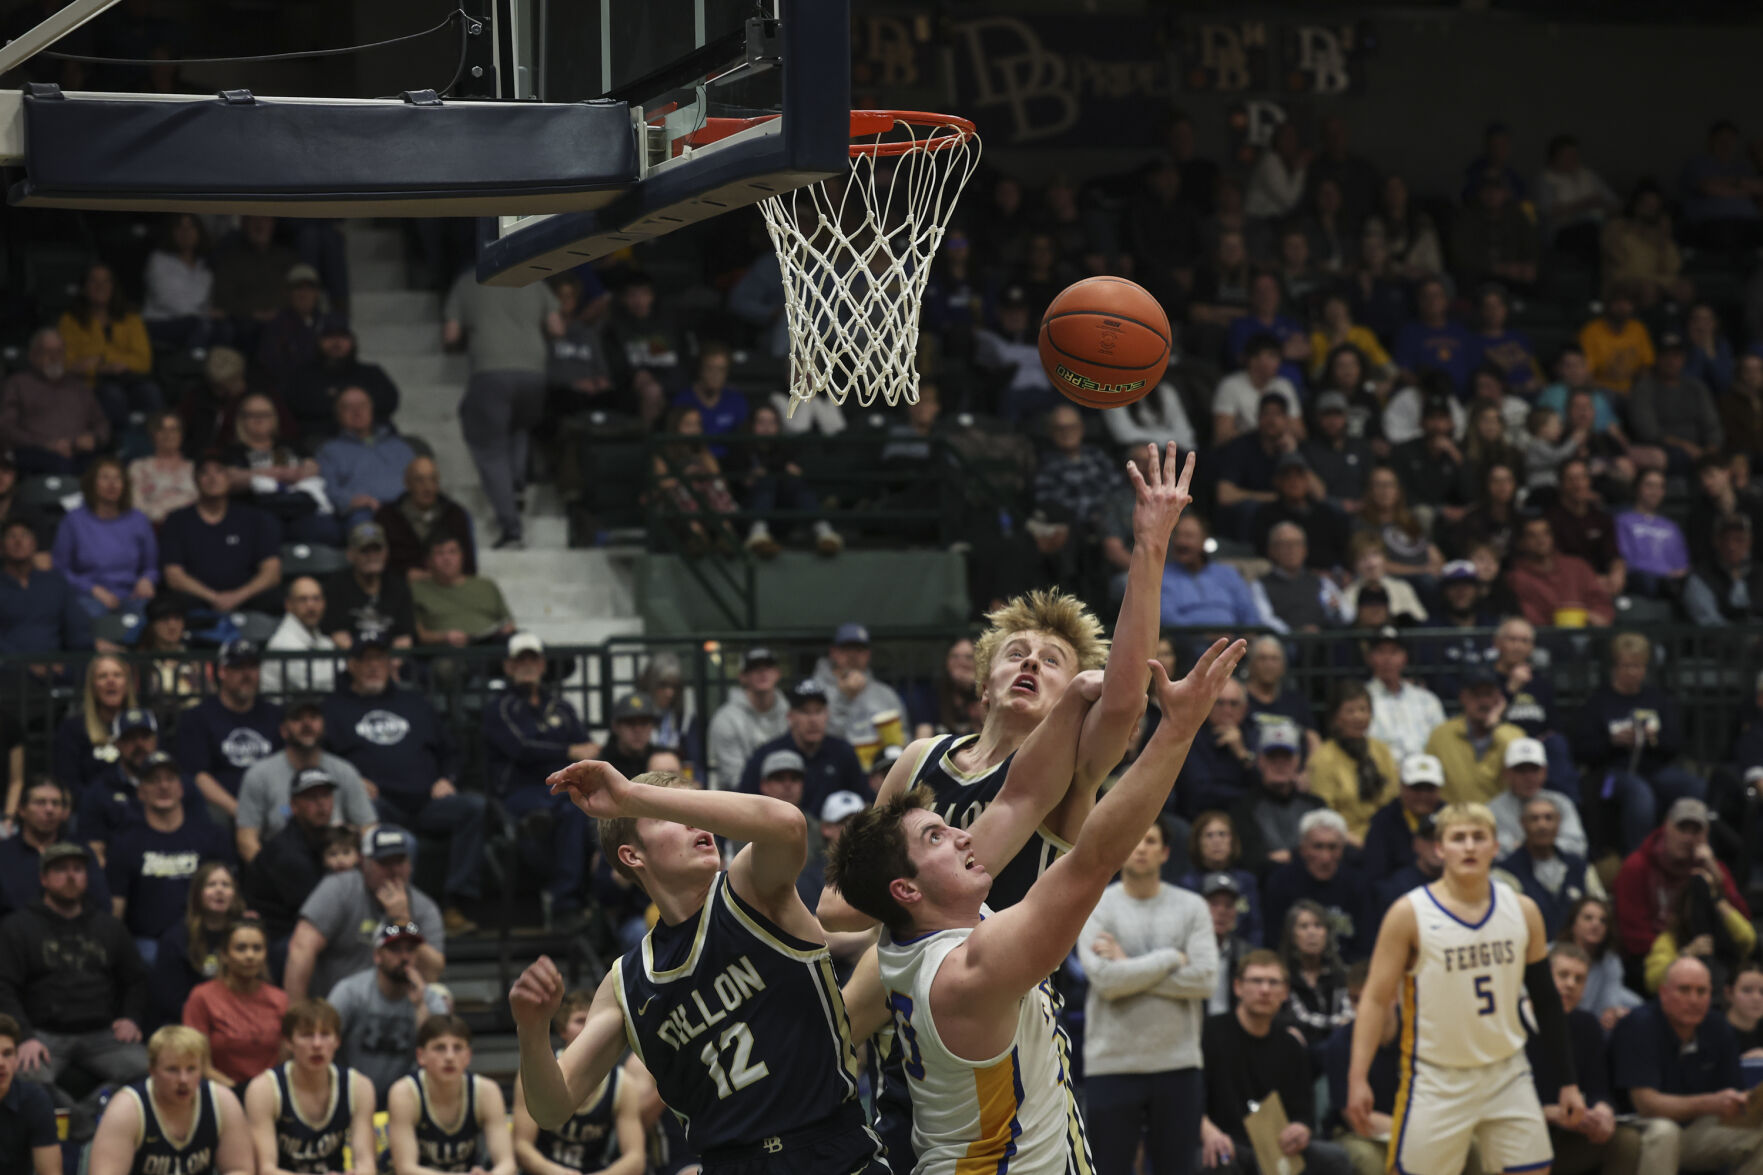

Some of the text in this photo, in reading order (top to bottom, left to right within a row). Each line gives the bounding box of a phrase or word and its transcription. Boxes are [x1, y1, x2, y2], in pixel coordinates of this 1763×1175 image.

[1444, 939, 1514, 972] FERGUS
[656, 955, 767, 1051] DILLON
[1474, 975, 1495, 1016] 5
[700, 1022, 770, 1101] 12
